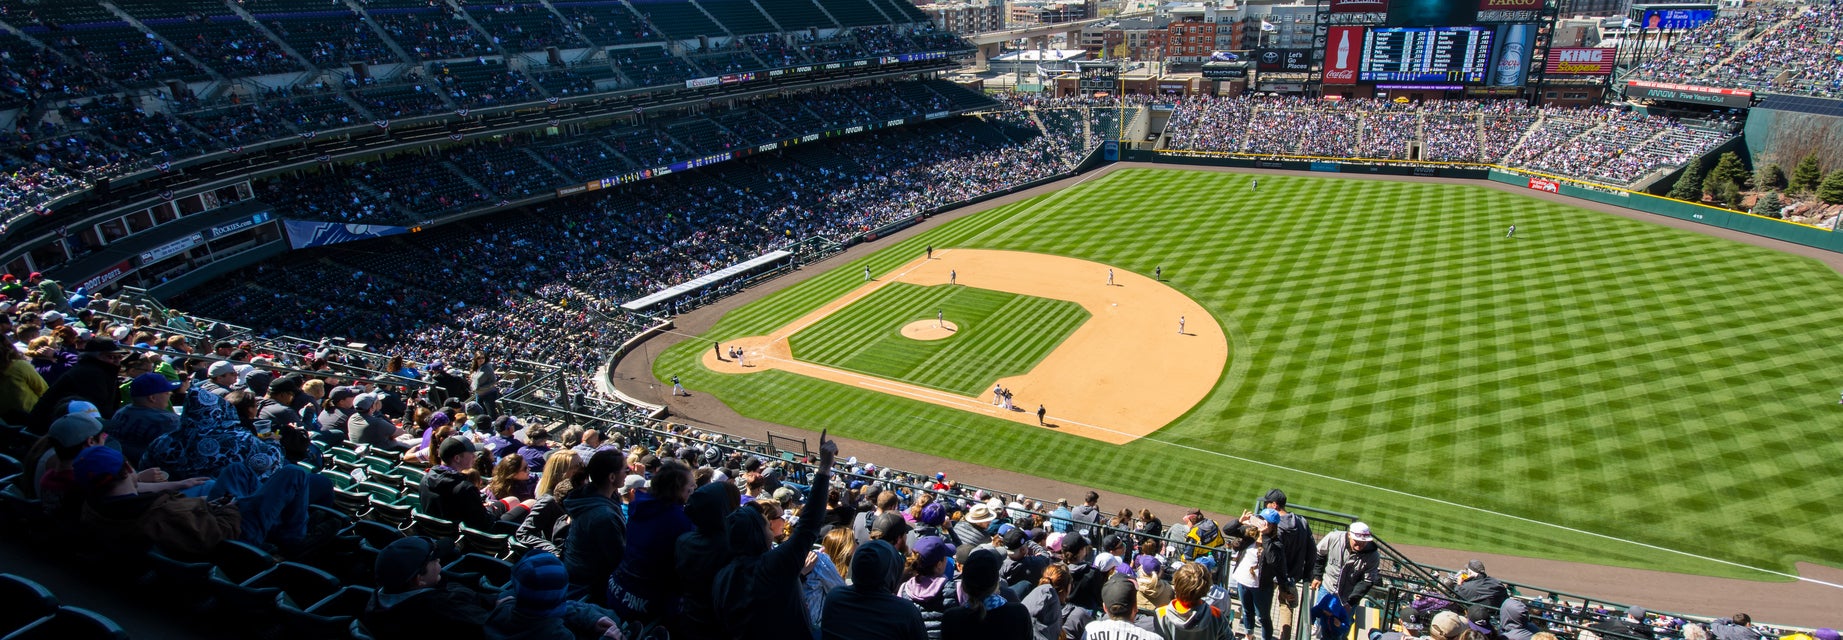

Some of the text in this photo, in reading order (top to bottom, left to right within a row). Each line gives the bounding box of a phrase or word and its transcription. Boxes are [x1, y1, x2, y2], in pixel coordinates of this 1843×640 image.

[1560, 50, 1602, 61] KING
[1557, 62, 1600, 74] Soopers
[1326, 70, 1354, 79] Coca-Cola
[1648, 89, 1676, 98] ARROW
[213, 220, 252, 236] ROCKIES.com
[84, 267, 121, 290] ROOT SPORTS
[622, 592, 648, 613] PINK
